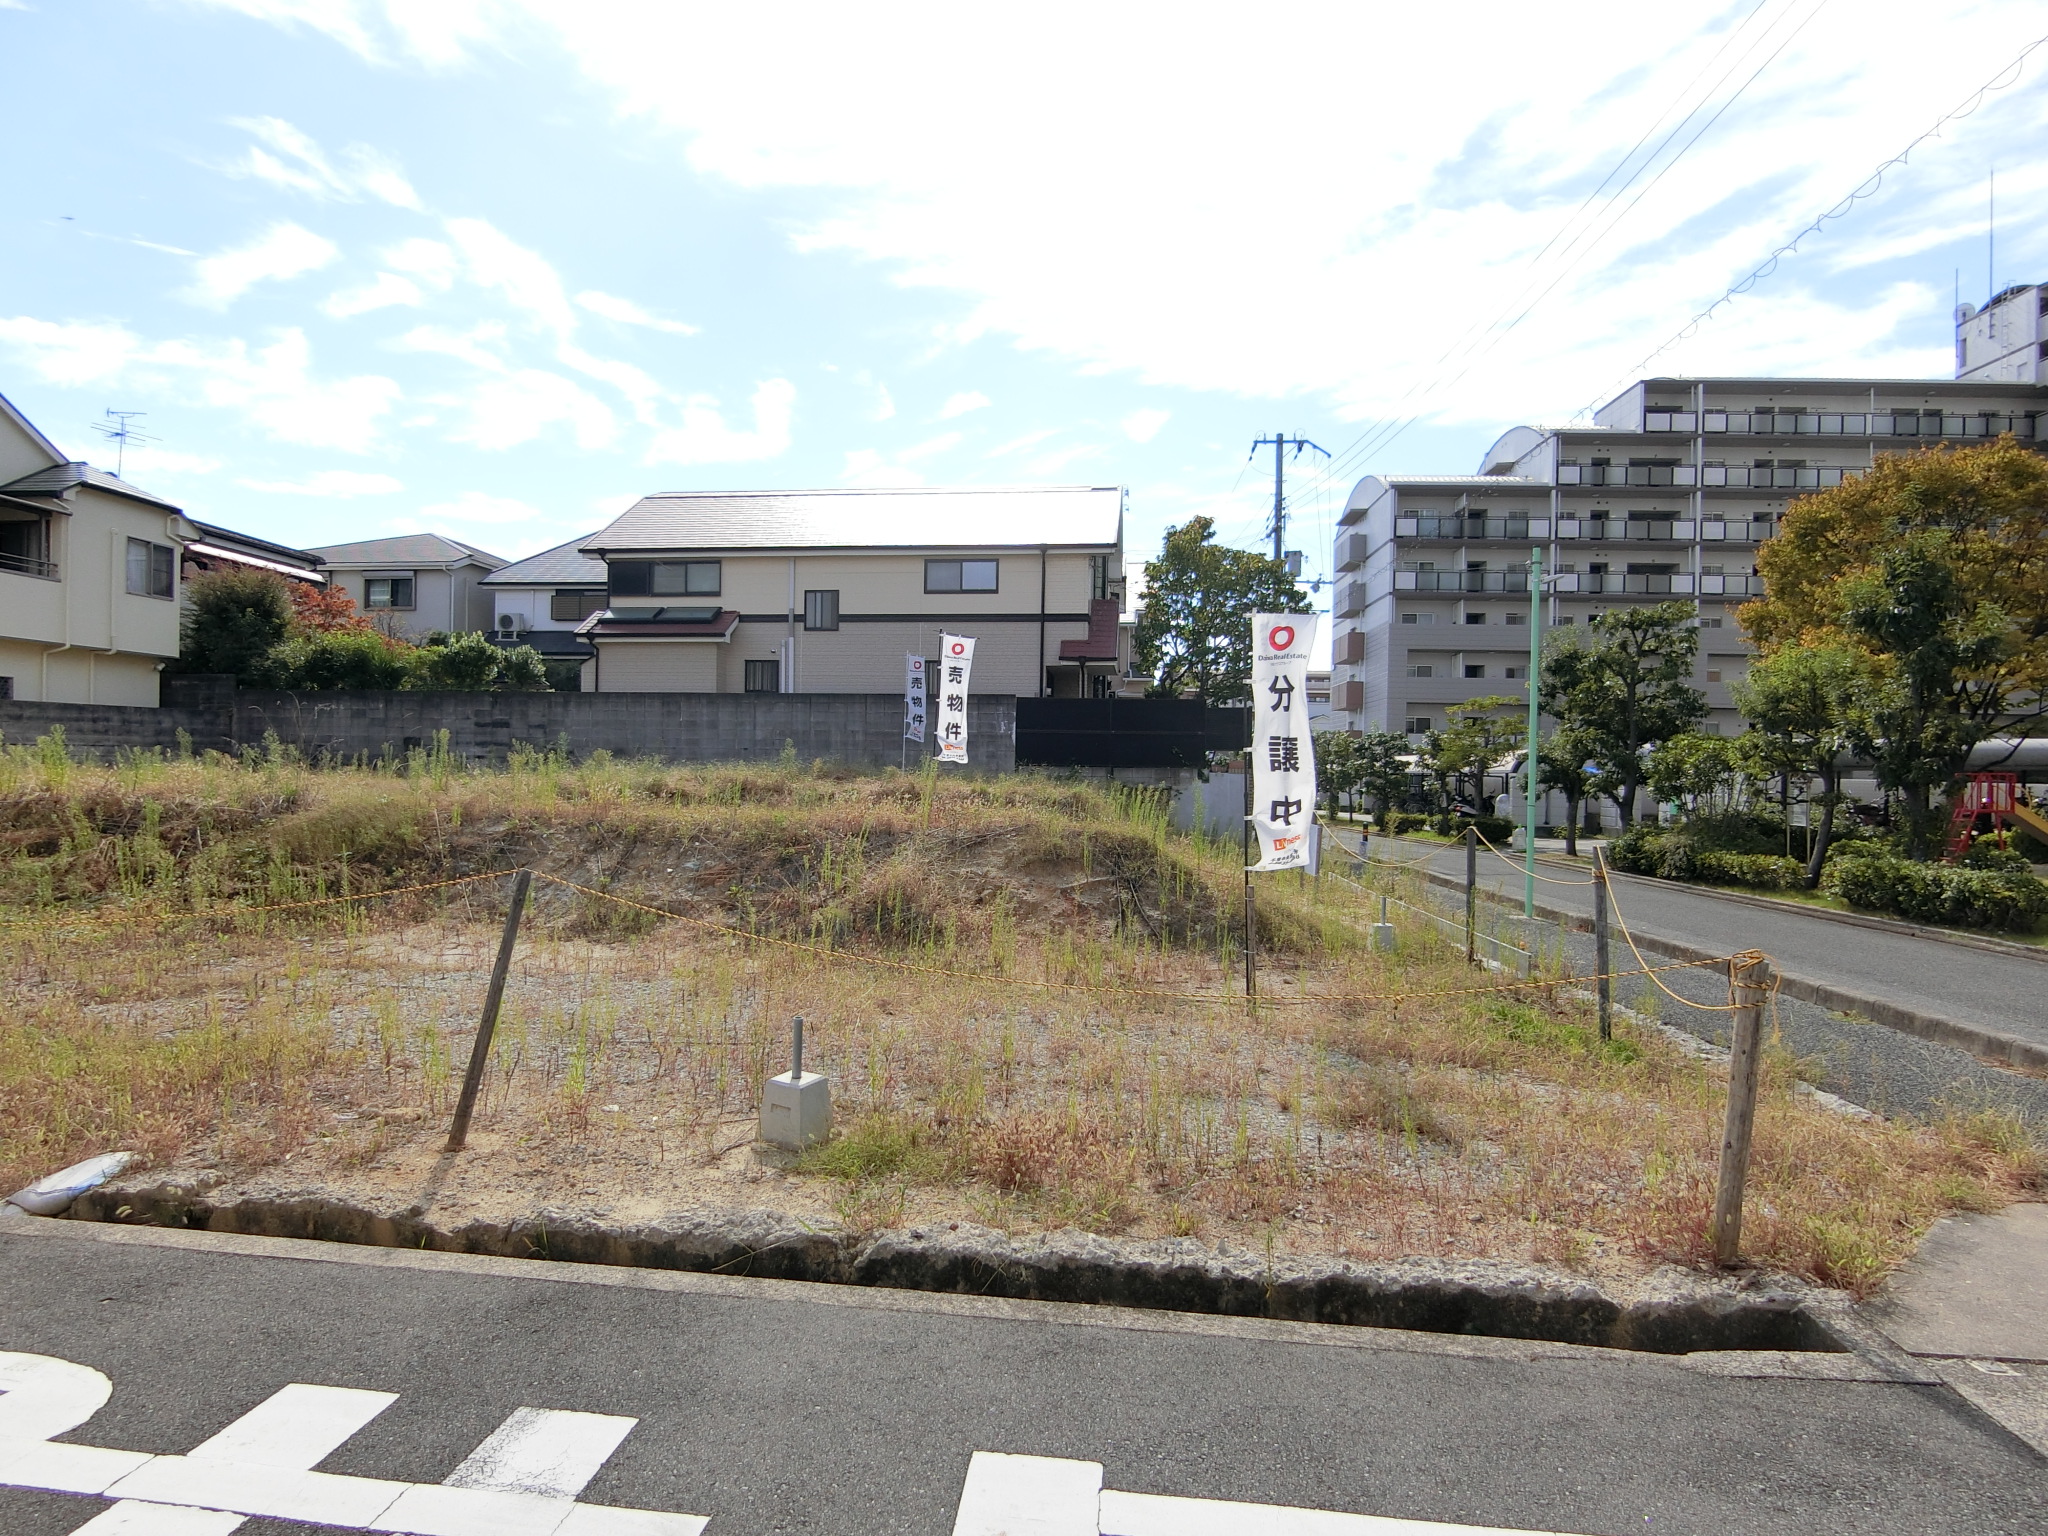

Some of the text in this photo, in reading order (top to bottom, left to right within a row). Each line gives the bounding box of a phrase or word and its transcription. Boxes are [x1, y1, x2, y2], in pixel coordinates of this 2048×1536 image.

[911, 677, 924, 727] 売物件
[945, 666, 964, 741] 売物件
[1268, 674, 1302, 826] 分譲中
